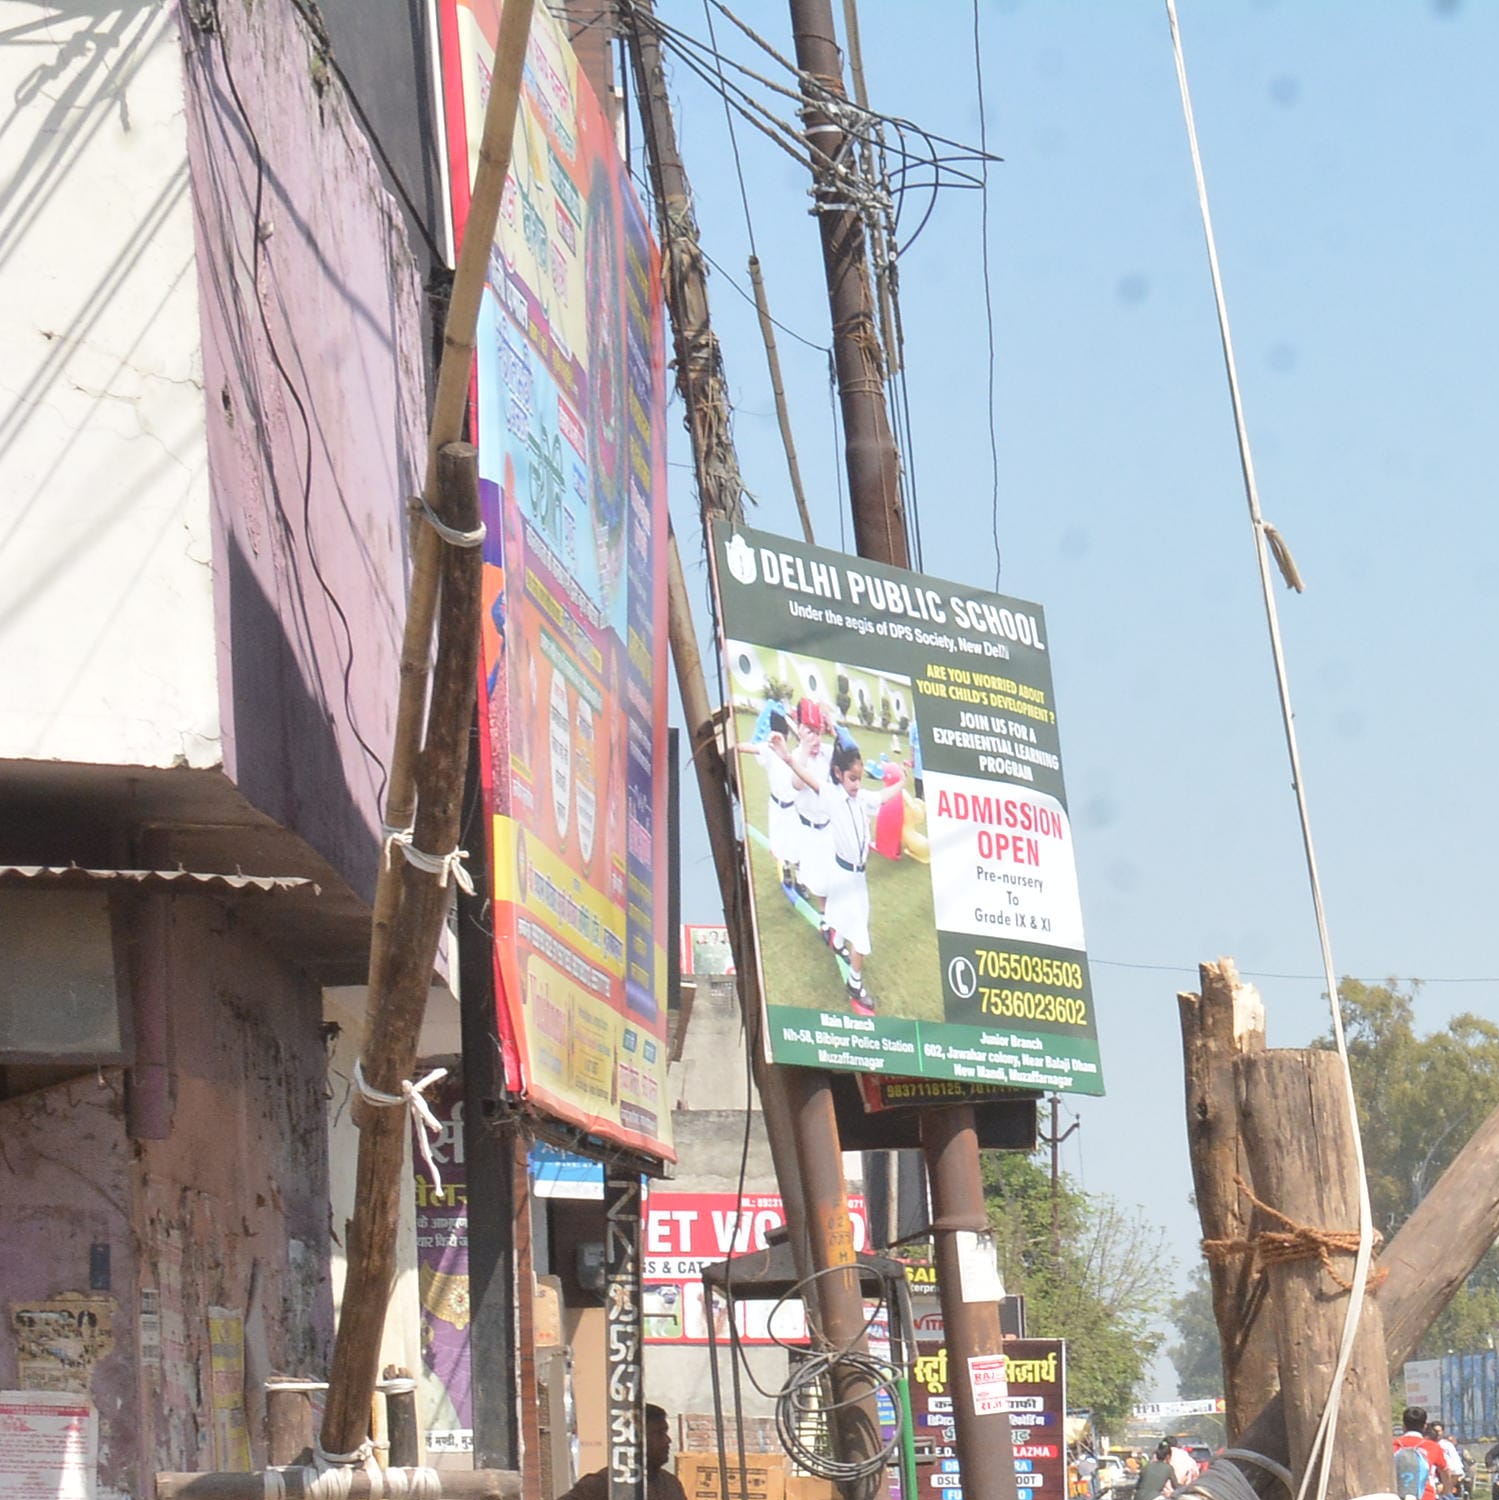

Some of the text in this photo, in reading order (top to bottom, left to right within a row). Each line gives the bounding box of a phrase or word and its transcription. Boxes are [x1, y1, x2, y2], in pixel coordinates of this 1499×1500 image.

[759, 547, 1044, 649] DELHI PUBLIC SCHOOL
[789, 601, 981, 654] Under the aegis of DPS Society, New
[916, 680, 988, 705] YOUR CHILD'S
[927, 664, 1044, 704] ARE YOU WORRIED ABOUT
[960, 711, 1028, 739] JOIN US FOR
[933, 728, 1059, 770] EXPERIENTIAL LEARNING
[979, 755, 1033, 781] PROGRAM
[938, 790, 1063, 840] ADMISSION
[978, 830, 1040, 866] OPEN
[977, 866, 1043, 892] Pre-nursery
[1006, 891, 1019, 906] To
[975, 908, 1026, 928] Grade IX
[975, 950, 1082, 990] 7055035503
[821, 1013, 874, 1032] Main Branch
[978, 988, 1087, 1026] 7536023602
[852, 1035, 914, 1054] Police Station
[1011, 1035, 1042, 1051] Branch
[647, 1211, 698, 1252] ET
